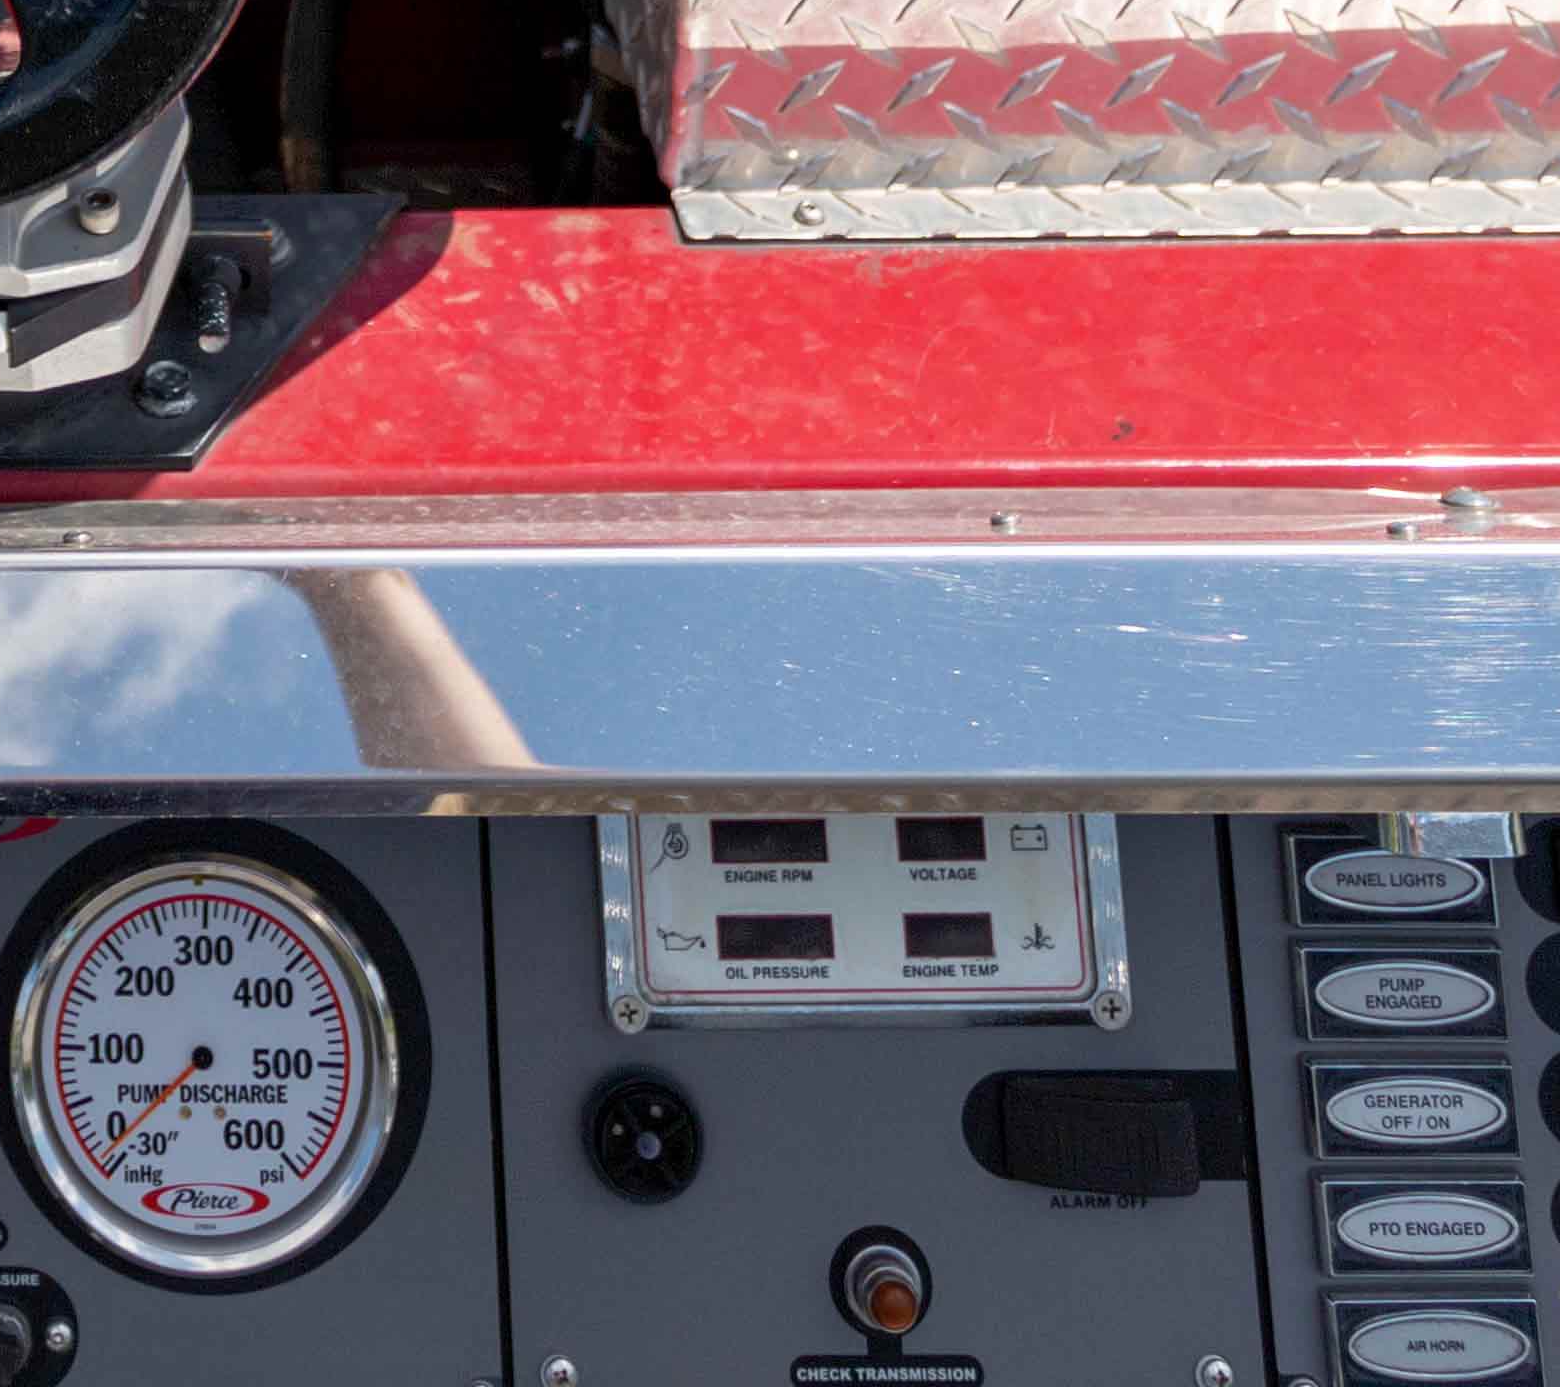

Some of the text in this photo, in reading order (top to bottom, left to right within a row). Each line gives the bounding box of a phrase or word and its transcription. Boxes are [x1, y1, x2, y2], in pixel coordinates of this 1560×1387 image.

[724, 870, 813, 883] ENGINE RPM
[909, 868, 977, 881] VOLTAGE
[1336, 873, 1447, 888] PANEL LIGHTS
[174, 935, 233, 965] 300
[726, 966, 829, 980] OIL PRESSURE
[903, 964, 999, 978] ENGINE TEMP
[115, 966, 174, 996] 200
[1379, 978, 1424, 992] PUMP
[233, 977, 293, 1008] 400
[1365, 995, 1442, 1009] ENGAGED
[88, 1033, 143, 1064] 100
[252, 1048, 312, 1079] 500
[180, 1084, 288, 1104] DISCHARGE
[1364, 1094, 1464, 1109] GENERATOR
[107, 1111, 127, 1141] 0
[1381, 1115, 1412, 1129] OFF
[1426, 1115, 1450, 1129] ON
[224, 1119, 285, 1150] 600
[124, 1164, 162, 1186] inHg
[260, 1165, 284, 1184] psi
[170, 1188, 239, 1211] Pierce
[1050, 1194, 1111, 1209] ALARM
[1369, 1222, 1486, 1236] PTO ENGAGED
[1407, 1340, 1464, 1352] AIR HORN
[797, 1367, 977, 1382] CHECK TRANSMISSION
